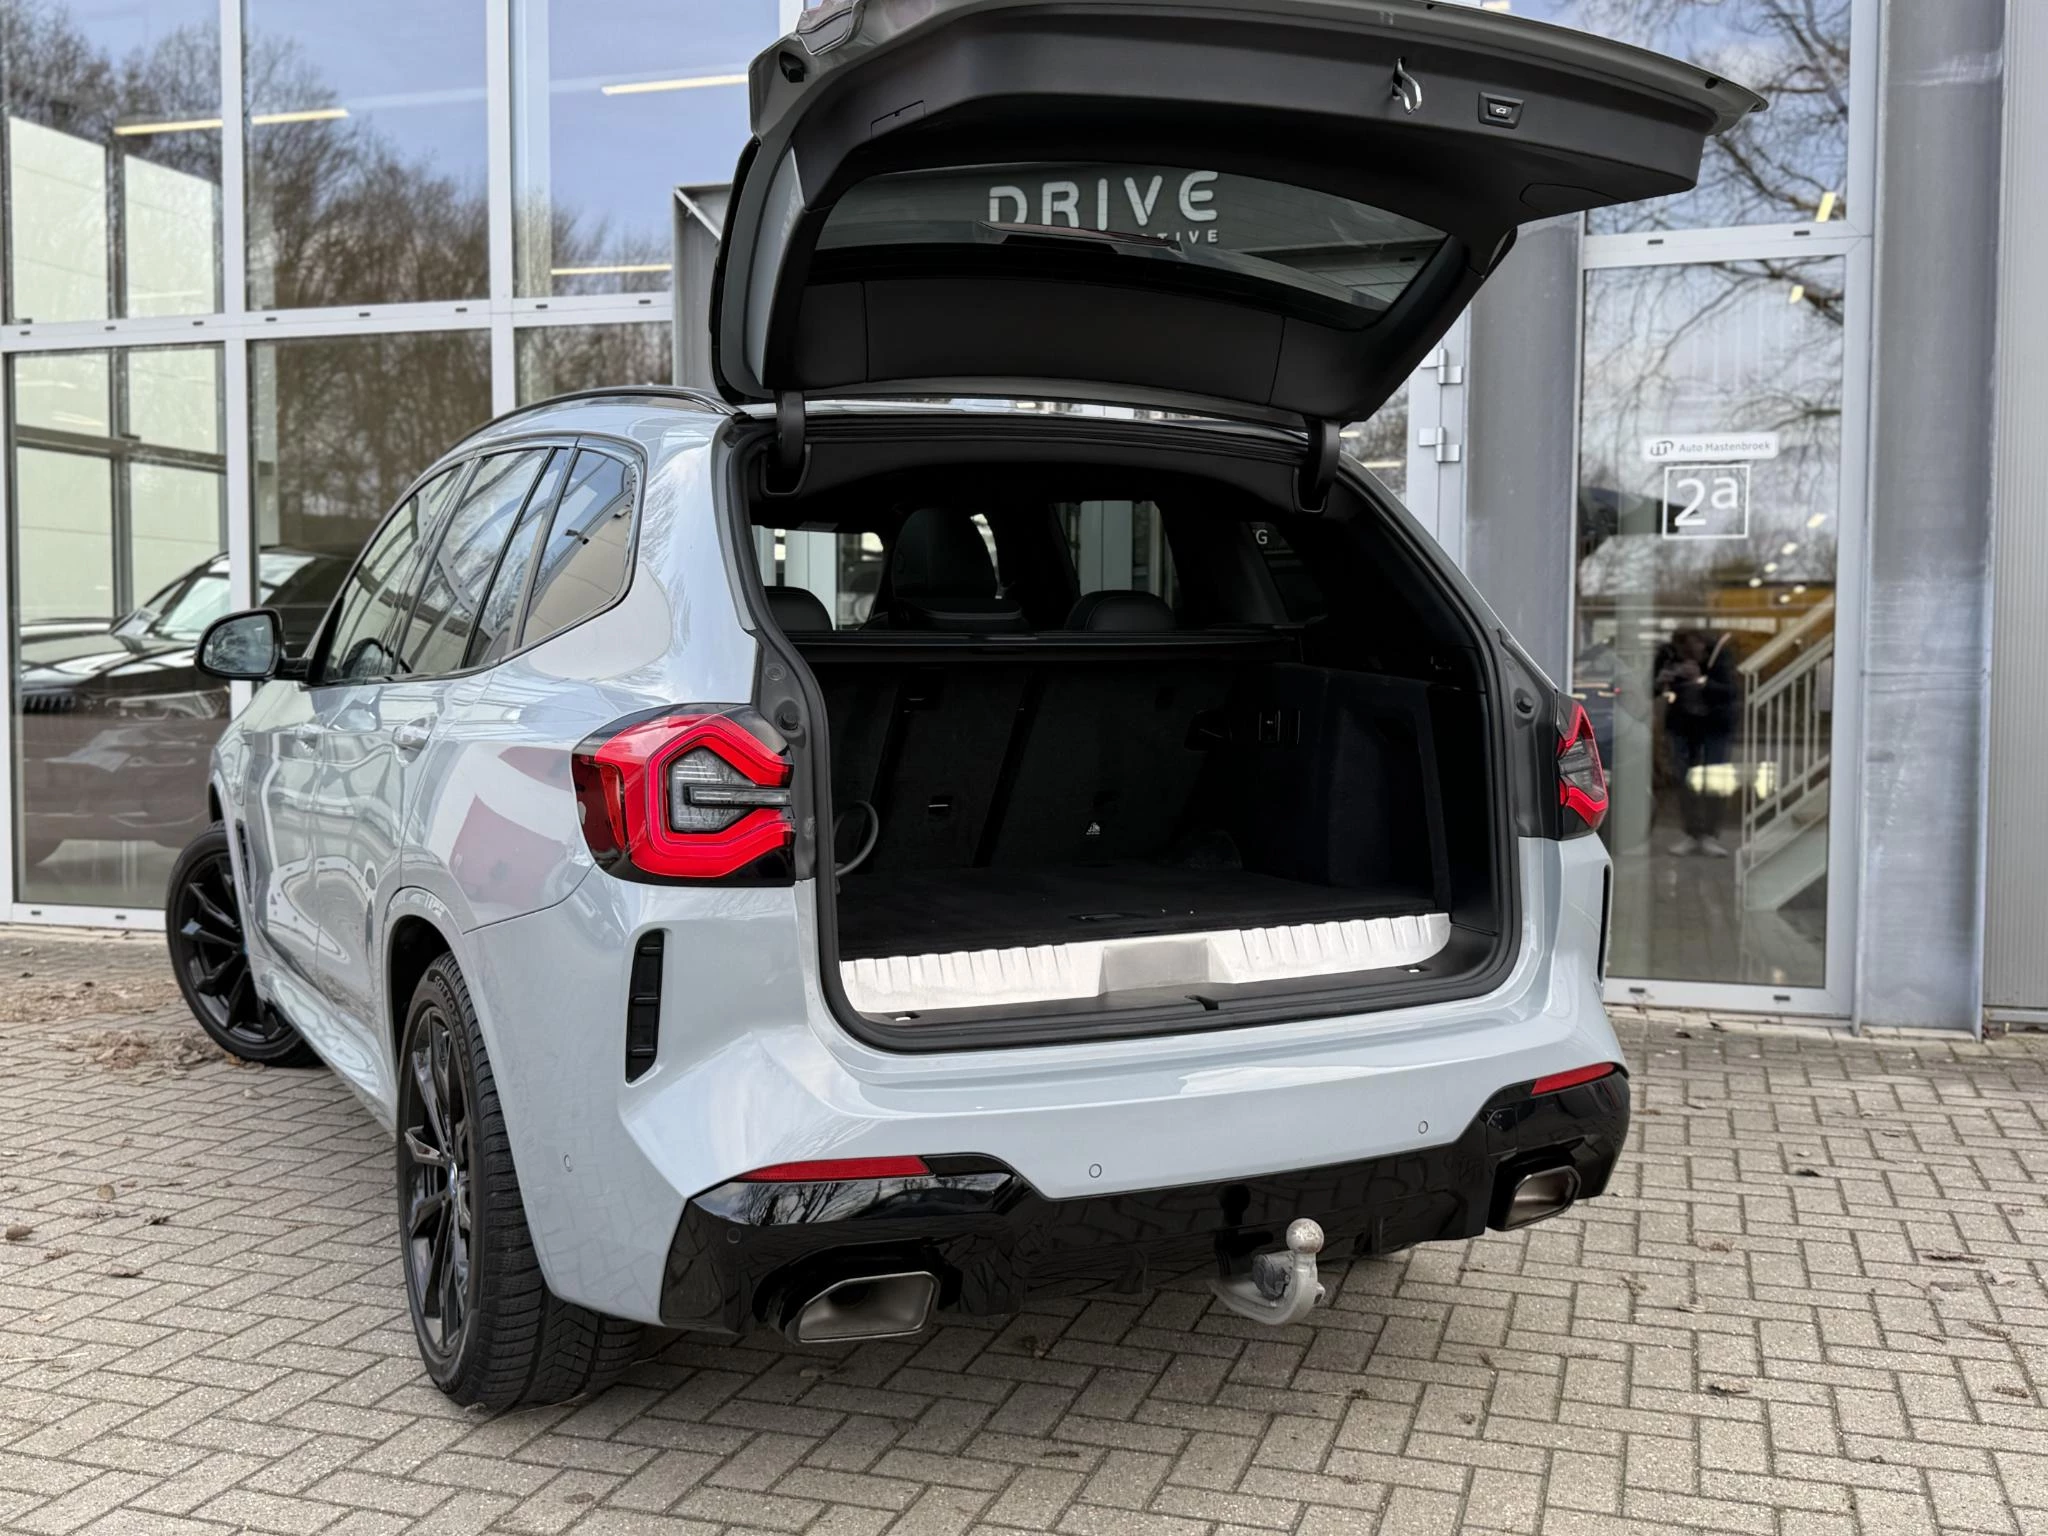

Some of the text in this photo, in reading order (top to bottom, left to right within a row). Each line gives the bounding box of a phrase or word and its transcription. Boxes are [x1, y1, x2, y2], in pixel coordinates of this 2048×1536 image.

[989, 170, 1219, 231] DRIVE
[1679, 443, 1703, 453] Auto
[1674, 476, 1739, 527] 2a
